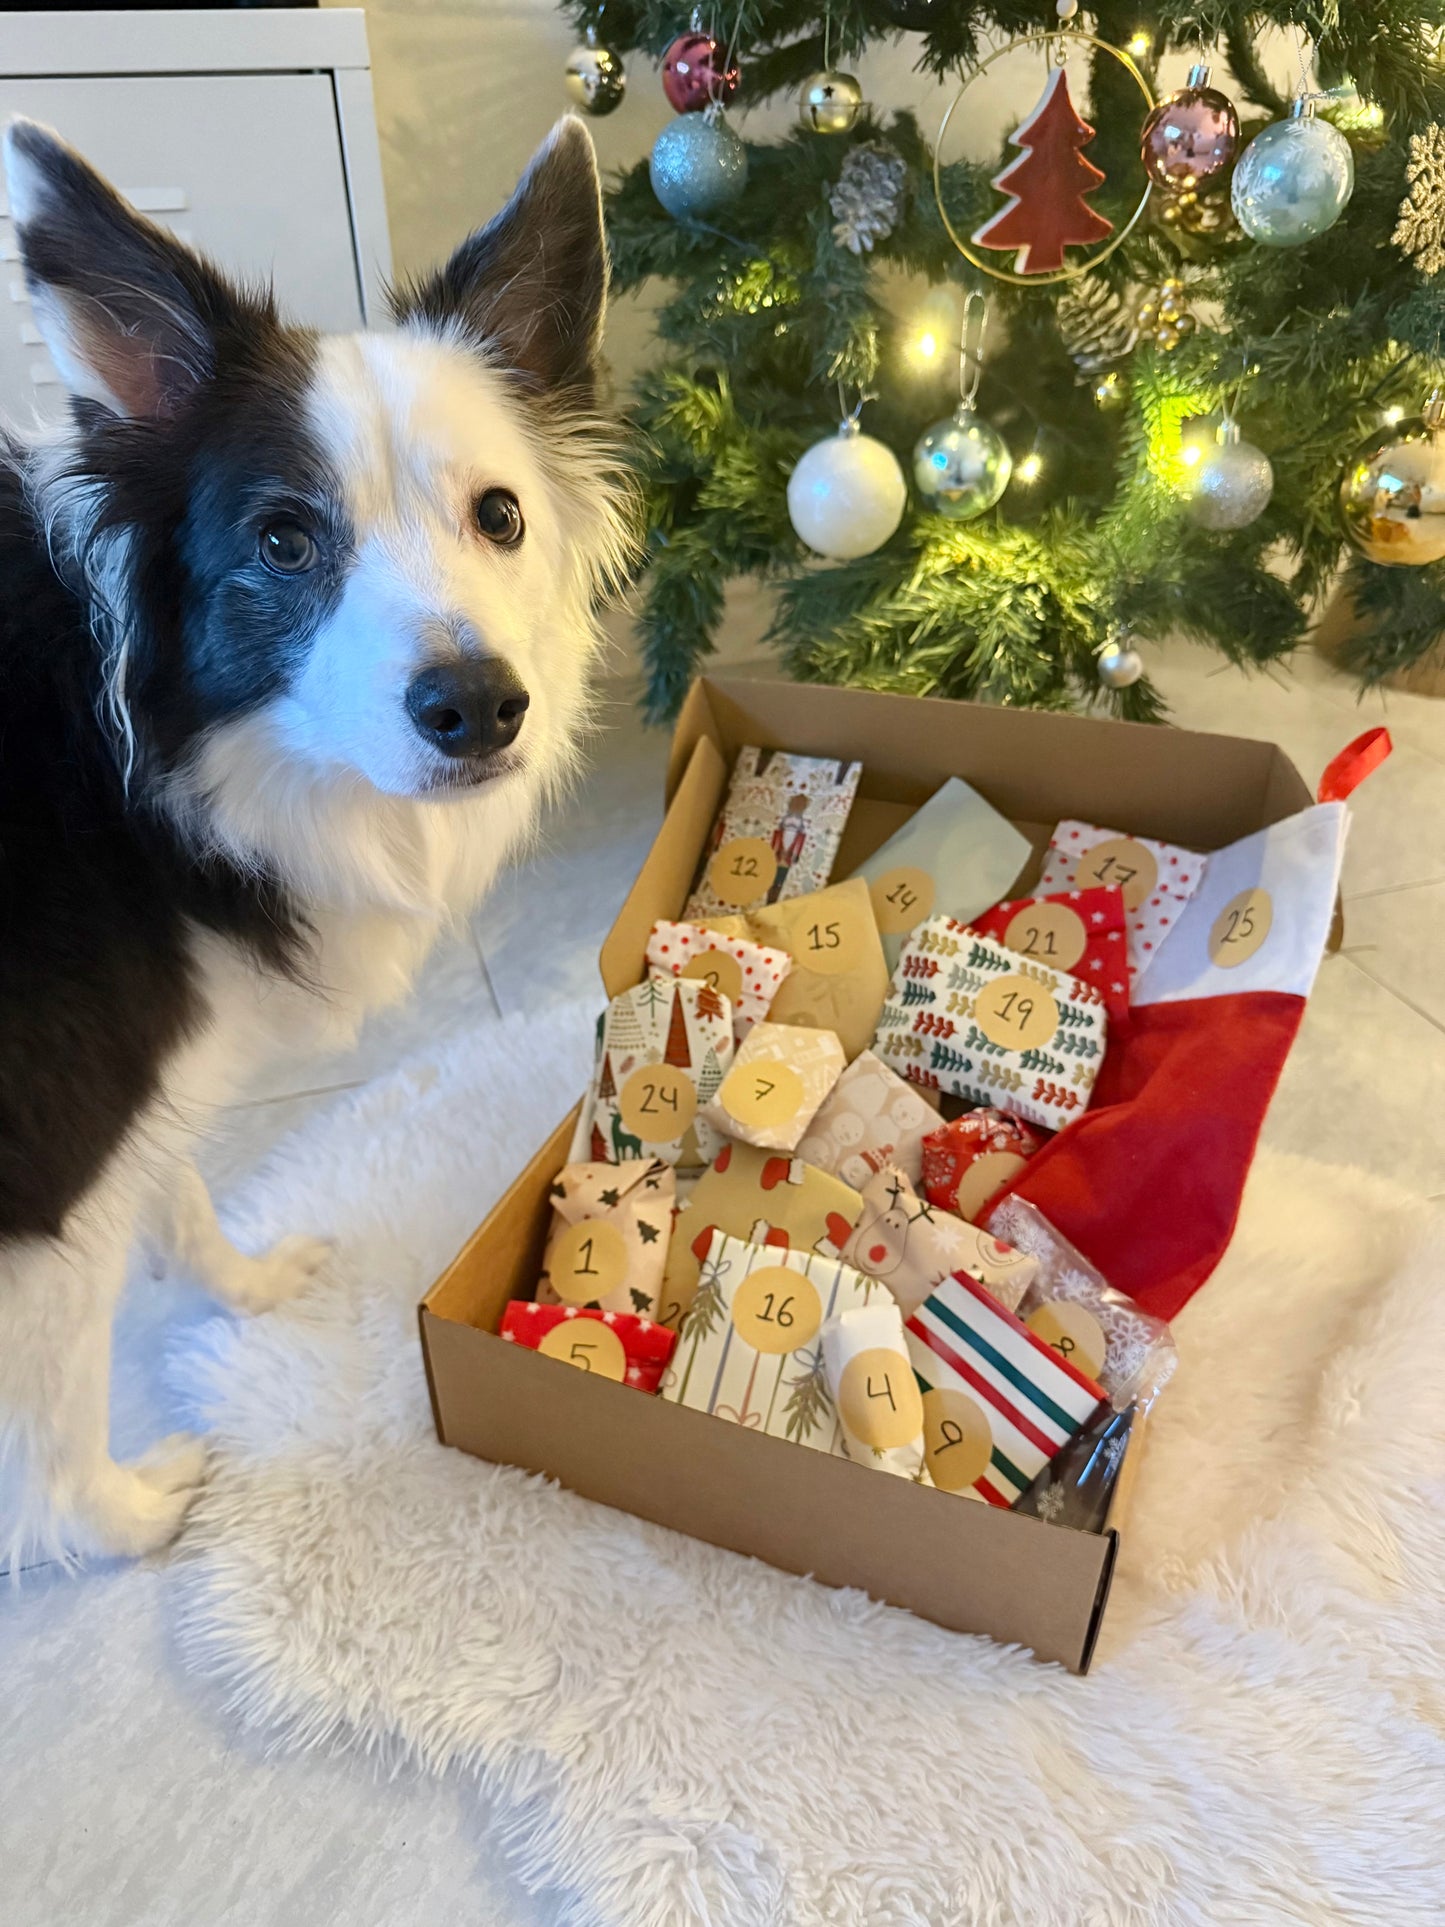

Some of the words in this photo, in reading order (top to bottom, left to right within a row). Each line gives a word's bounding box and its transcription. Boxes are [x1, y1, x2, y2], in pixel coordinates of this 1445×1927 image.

[730, 855, 759, 878] 12
[1093, 856, 1137, 887] 17
[886, 883, 917, 913] 14
[808, 922, 841, 951] 15
[1220, 906, 1255, 944] 25
[1021, 927, 1059, 955] 21
[993, 991, 1034, 1031] 19
[640, 1084, 678, 1113] 24
[755, 1078, 775, 1101] 7
[574, 1238, 599, 1275] 1
[755, 1292, 795, 1327] 16
[570, 1343, 598, 1371] 5
[866, 1372, 897, 1412] 4
[934, 1419, 964, 1456] 9
